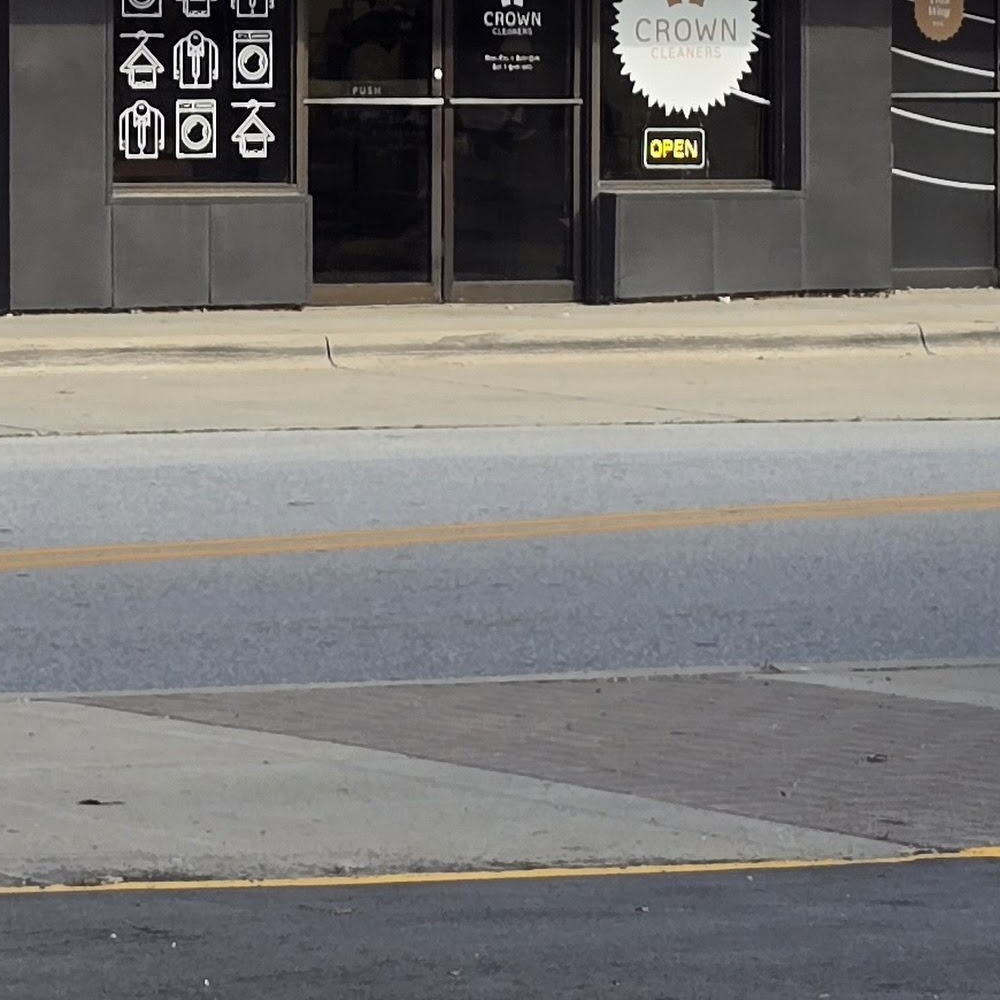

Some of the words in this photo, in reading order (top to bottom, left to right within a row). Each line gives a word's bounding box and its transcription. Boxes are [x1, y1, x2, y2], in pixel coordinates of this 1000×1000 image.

[483, 11, 542, 27] CROWN
[635, 17, 737, 43] CROWN
[650, 46, 722, 59] CLEANERS
[649, 138, 698, 159] OPEN
